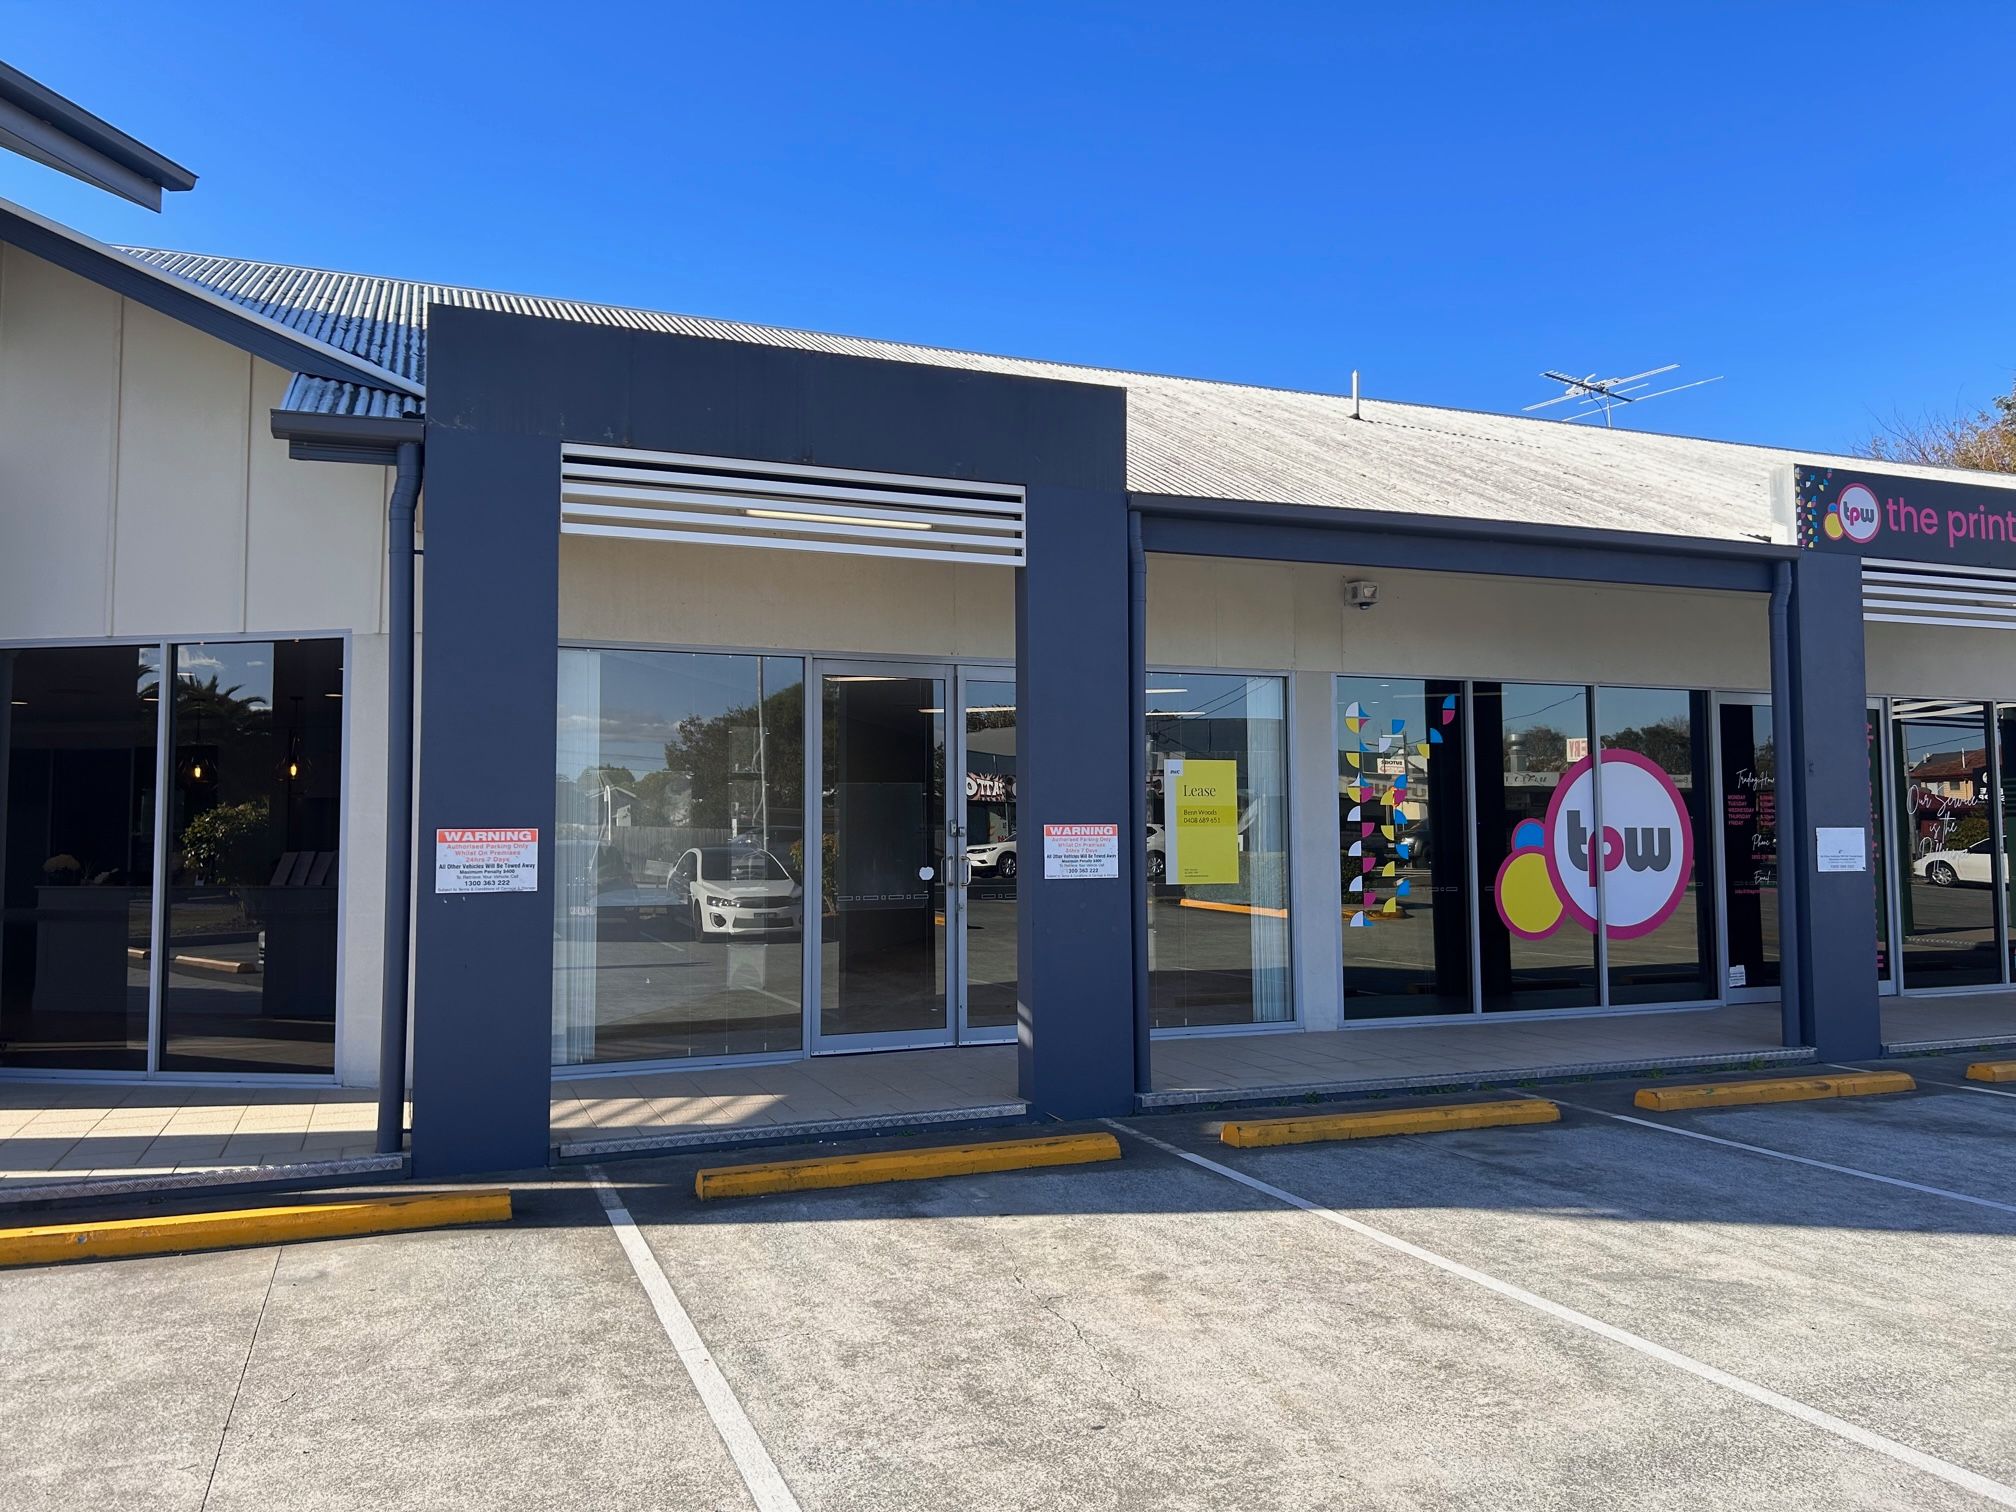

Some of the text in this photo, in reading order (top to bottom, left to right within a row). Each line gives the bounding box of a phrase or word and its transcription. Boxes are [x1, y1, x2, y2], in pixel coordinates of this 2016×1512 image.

[1843, 501, 1874, 526] tpw
[1886, 497, 2016, 548] the print
[1184, 785, 1216, 796] Lease
[1907, 784, 1978, 815] Our Service
[444, 831, 531, 841] WARNING
[1050, 827, 1113, 835] WARNING
[1929, 811, 1958, 844] is the
[1566, 810, 1672, 888] tpw
